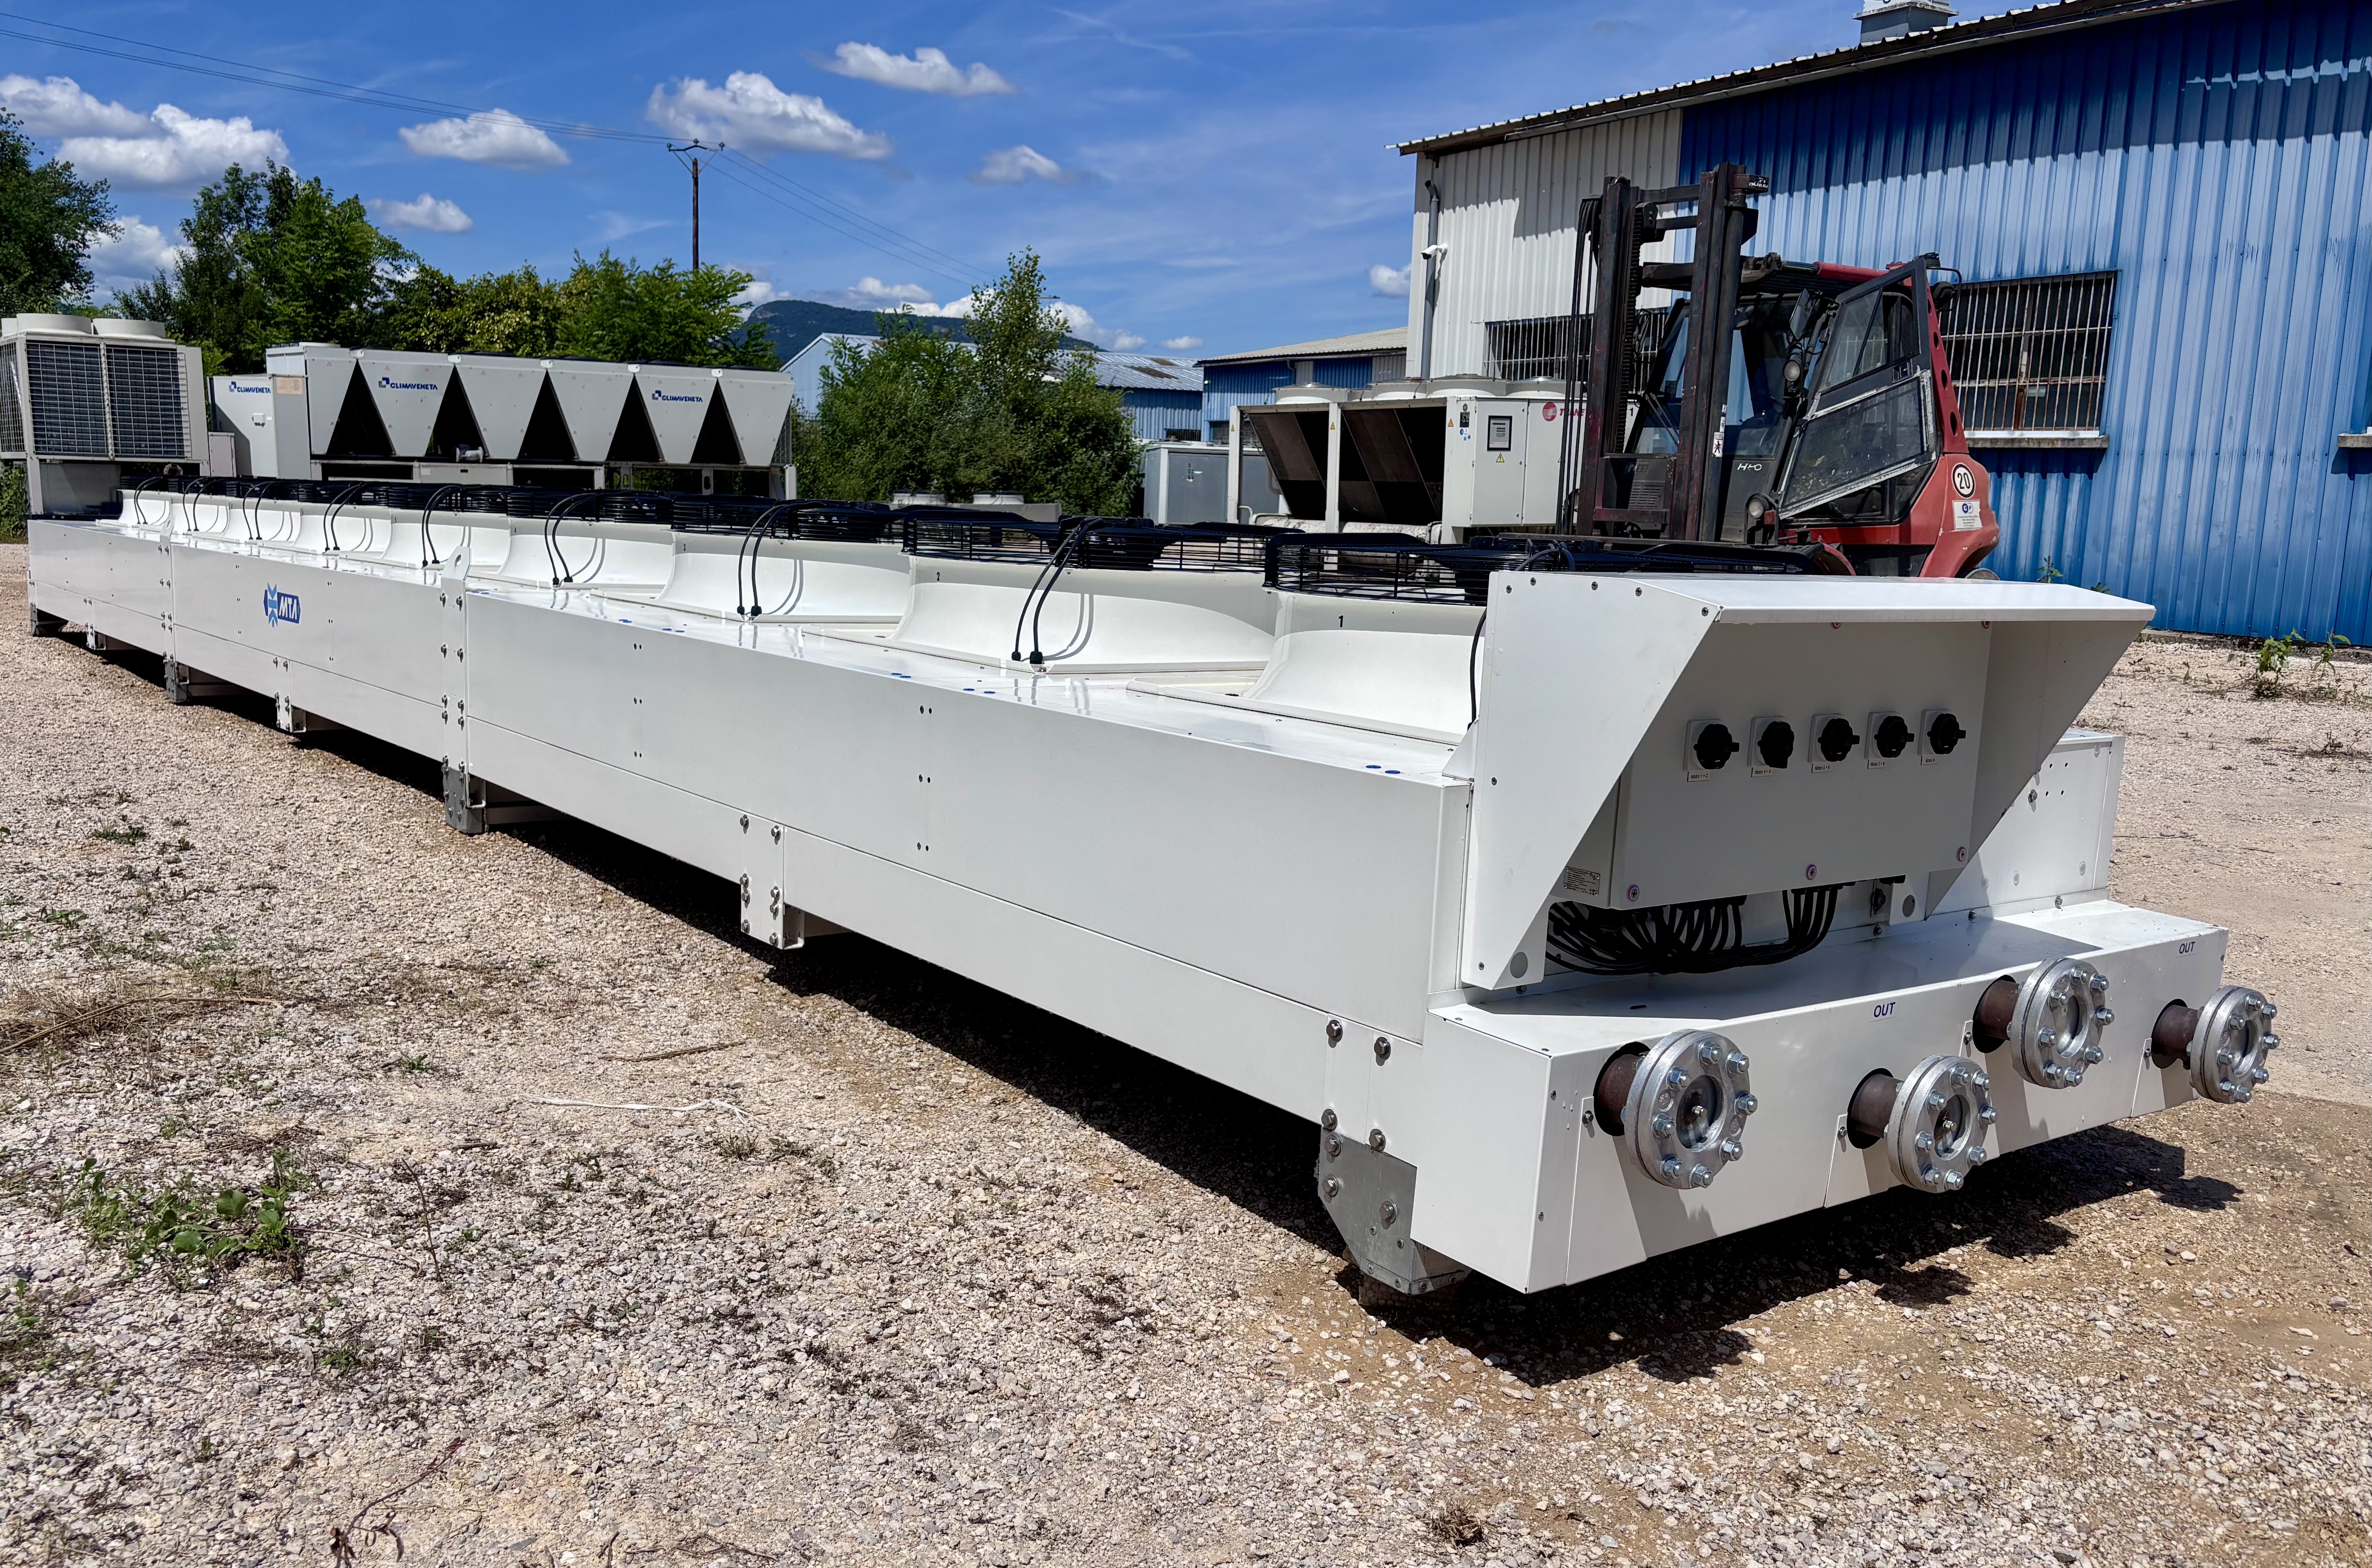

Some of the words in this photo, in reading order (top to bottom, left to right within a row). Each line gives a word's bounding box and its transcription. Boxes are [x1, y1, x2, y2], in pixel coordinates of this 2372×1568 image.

[1629, 407, 1634, 416] 1
[1957, 472, 1970, 489] 20
[937, 571, 940, 581] 2
[279, 596, 297, 620] MTA
[1339, 615, 1343, 627] 1
[2179, 941, 2196, 954] OUT
[1874, 1002, 1896, 1018] OUT
